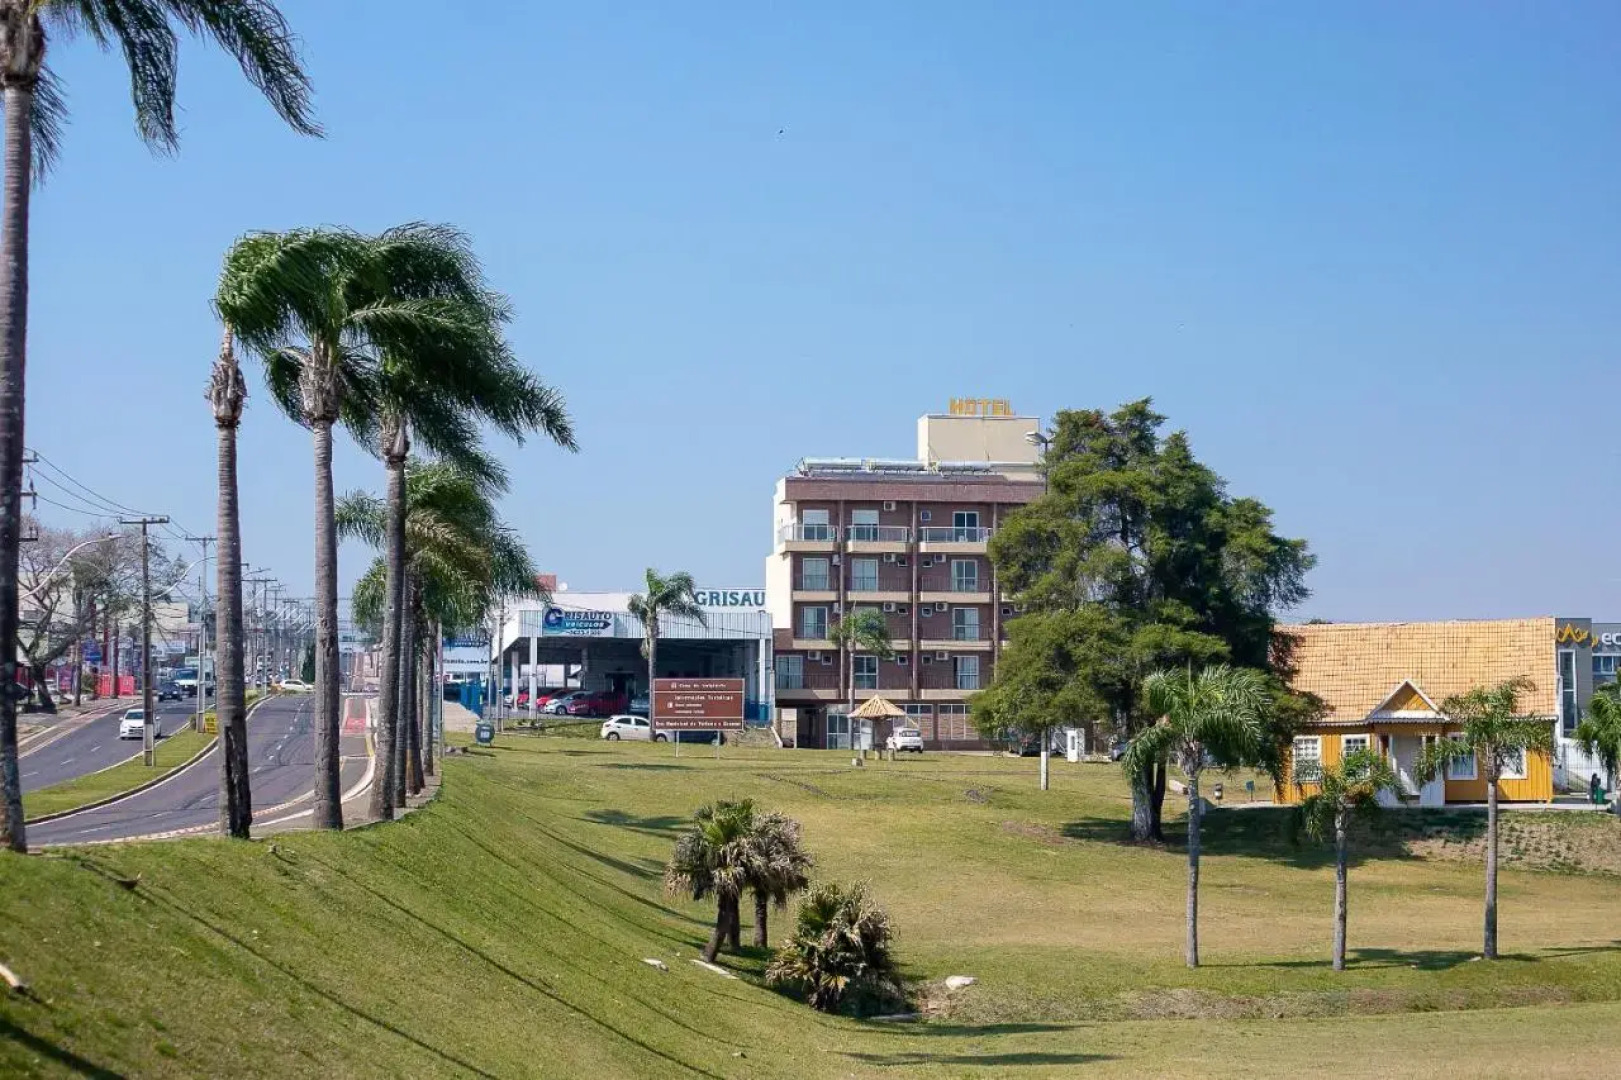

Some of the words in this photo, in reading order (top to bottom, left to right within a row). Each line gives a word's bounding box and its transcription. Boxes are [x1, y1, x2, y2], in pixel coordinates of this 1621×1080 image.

[949, 398, 1015, 415] HOTEL
[694, 590, 766, 606] GRISAU
[545, 608, 611, 627] GRISAUTO
